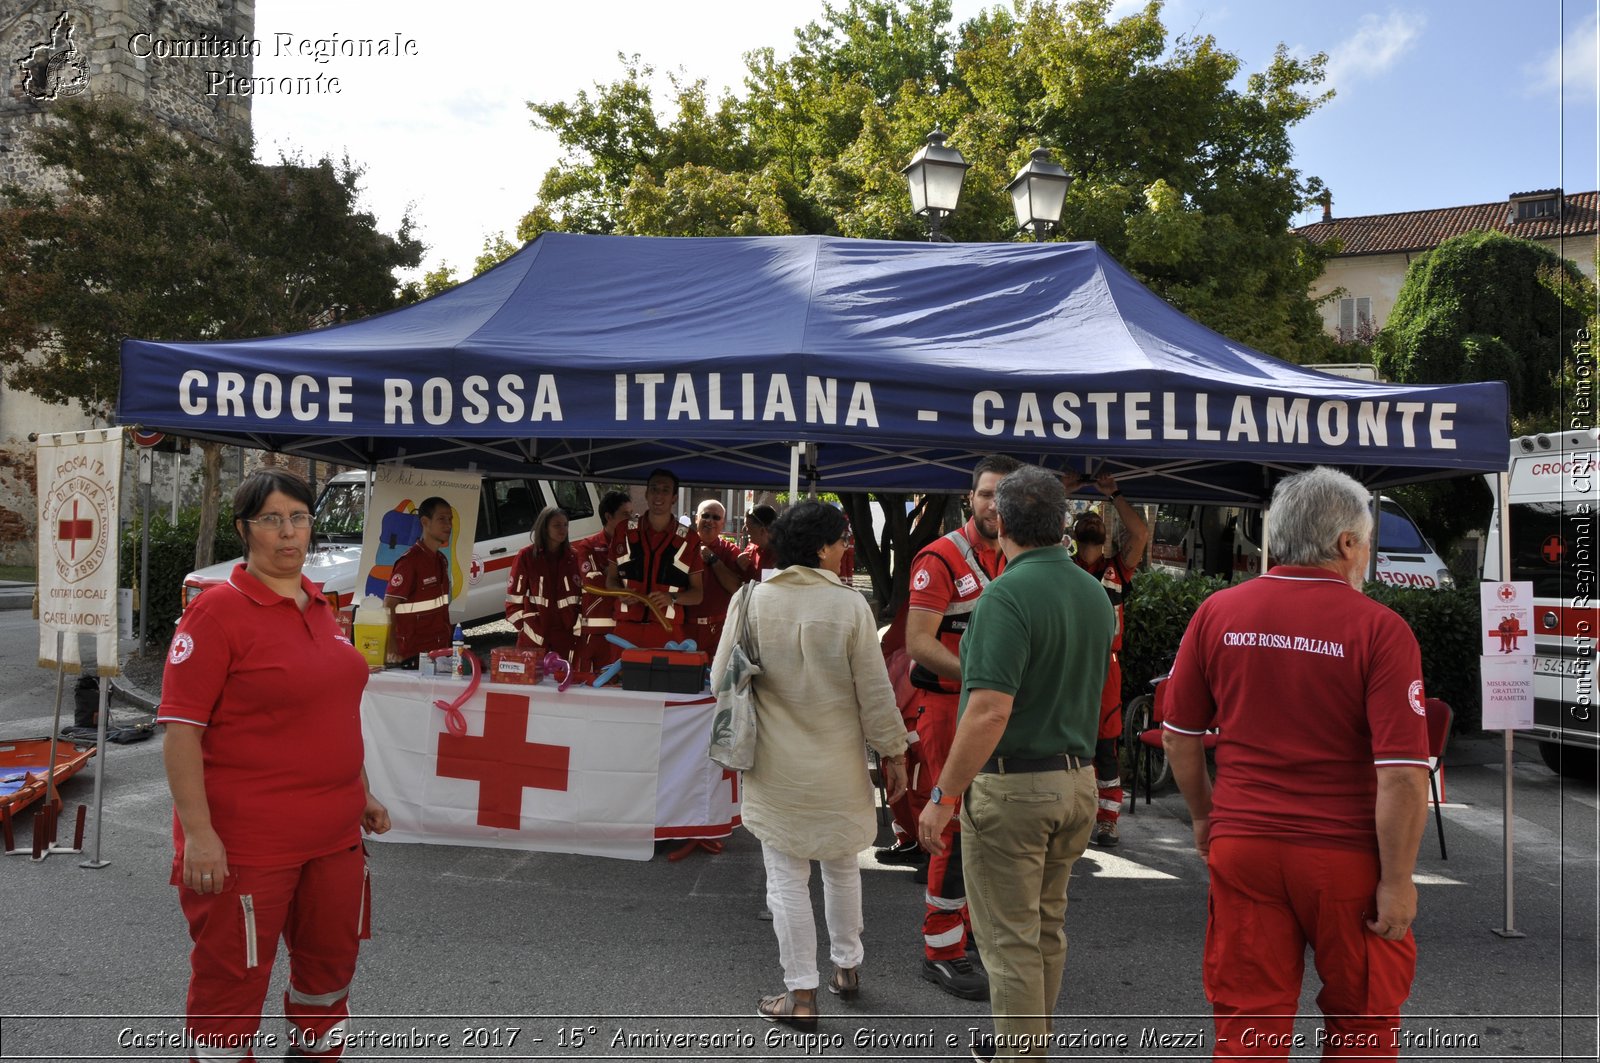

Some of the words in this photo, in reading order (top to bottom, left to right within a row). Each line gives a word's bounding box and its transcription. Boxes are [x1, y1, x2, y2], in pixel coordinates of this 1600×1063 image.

[178, 369, 354, 423] CROCE
[384, 373, 563, 425] ROSSA
[614, 372, 880, 428] ITALIANA
[917, 410, 939, 421] -
[972, 390, 1457, 450] CASTELLAMONTE
[1532, 461, 1582, 475] CROCE
[394, 470, 414, 486] kit
[415, 474, 427, 488] di
[73, 588, 108, 600] LOCALE
[1223, 632, 1257, 646] CROCE
[1258, 633, 1292, 649] ROSSA
[1292, 636, 1345, 657] ITALIANA
